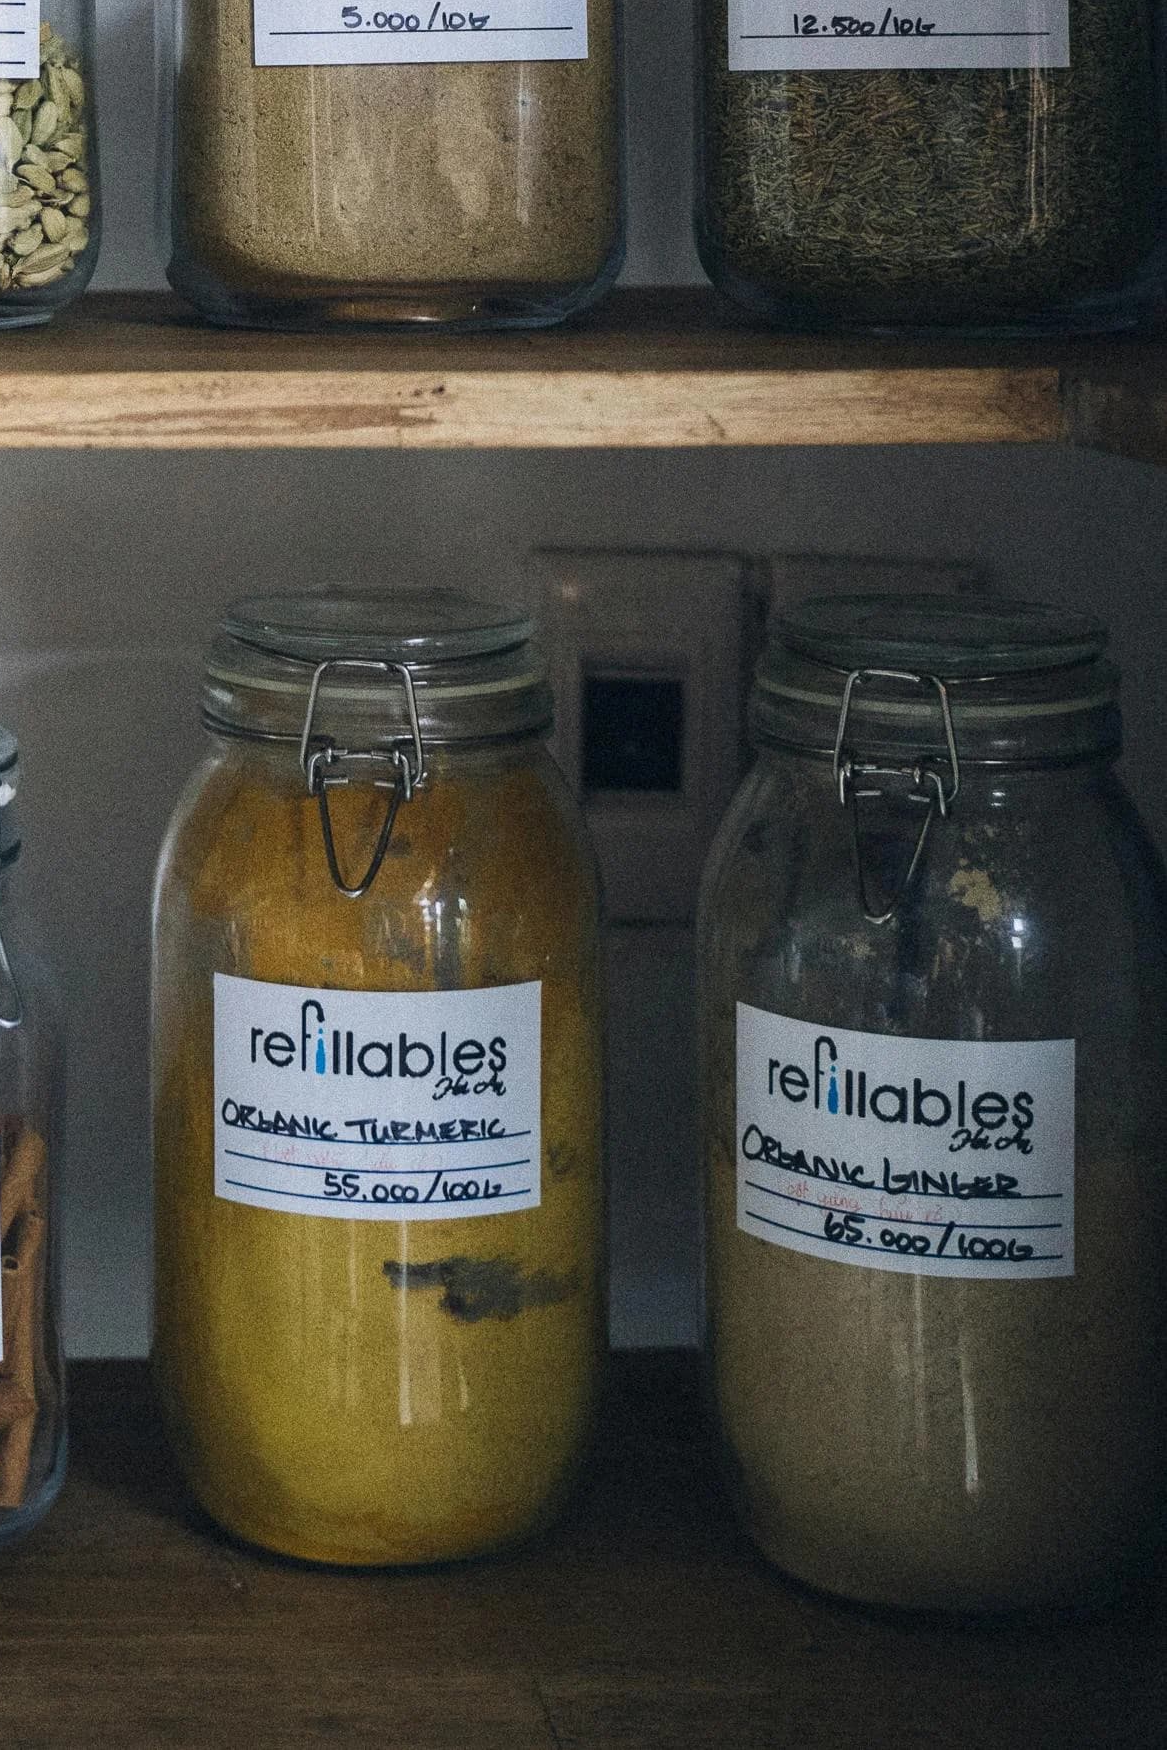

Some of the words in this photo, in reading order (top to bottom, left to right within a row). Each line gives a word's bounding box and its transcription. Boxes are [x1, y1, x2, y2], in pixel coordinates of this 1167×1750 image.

[250, 1000, 506, 1077] refillables
[222, 1098, 337, 1139] ORGANIC
[345, 1117, 506, 1142] TURMERIC
[769, 1036, 1034, 1130] refillables
[742, 1124, 874, 1188] ORGANIC
[883, 1157, 1021, 1199] GINGER
